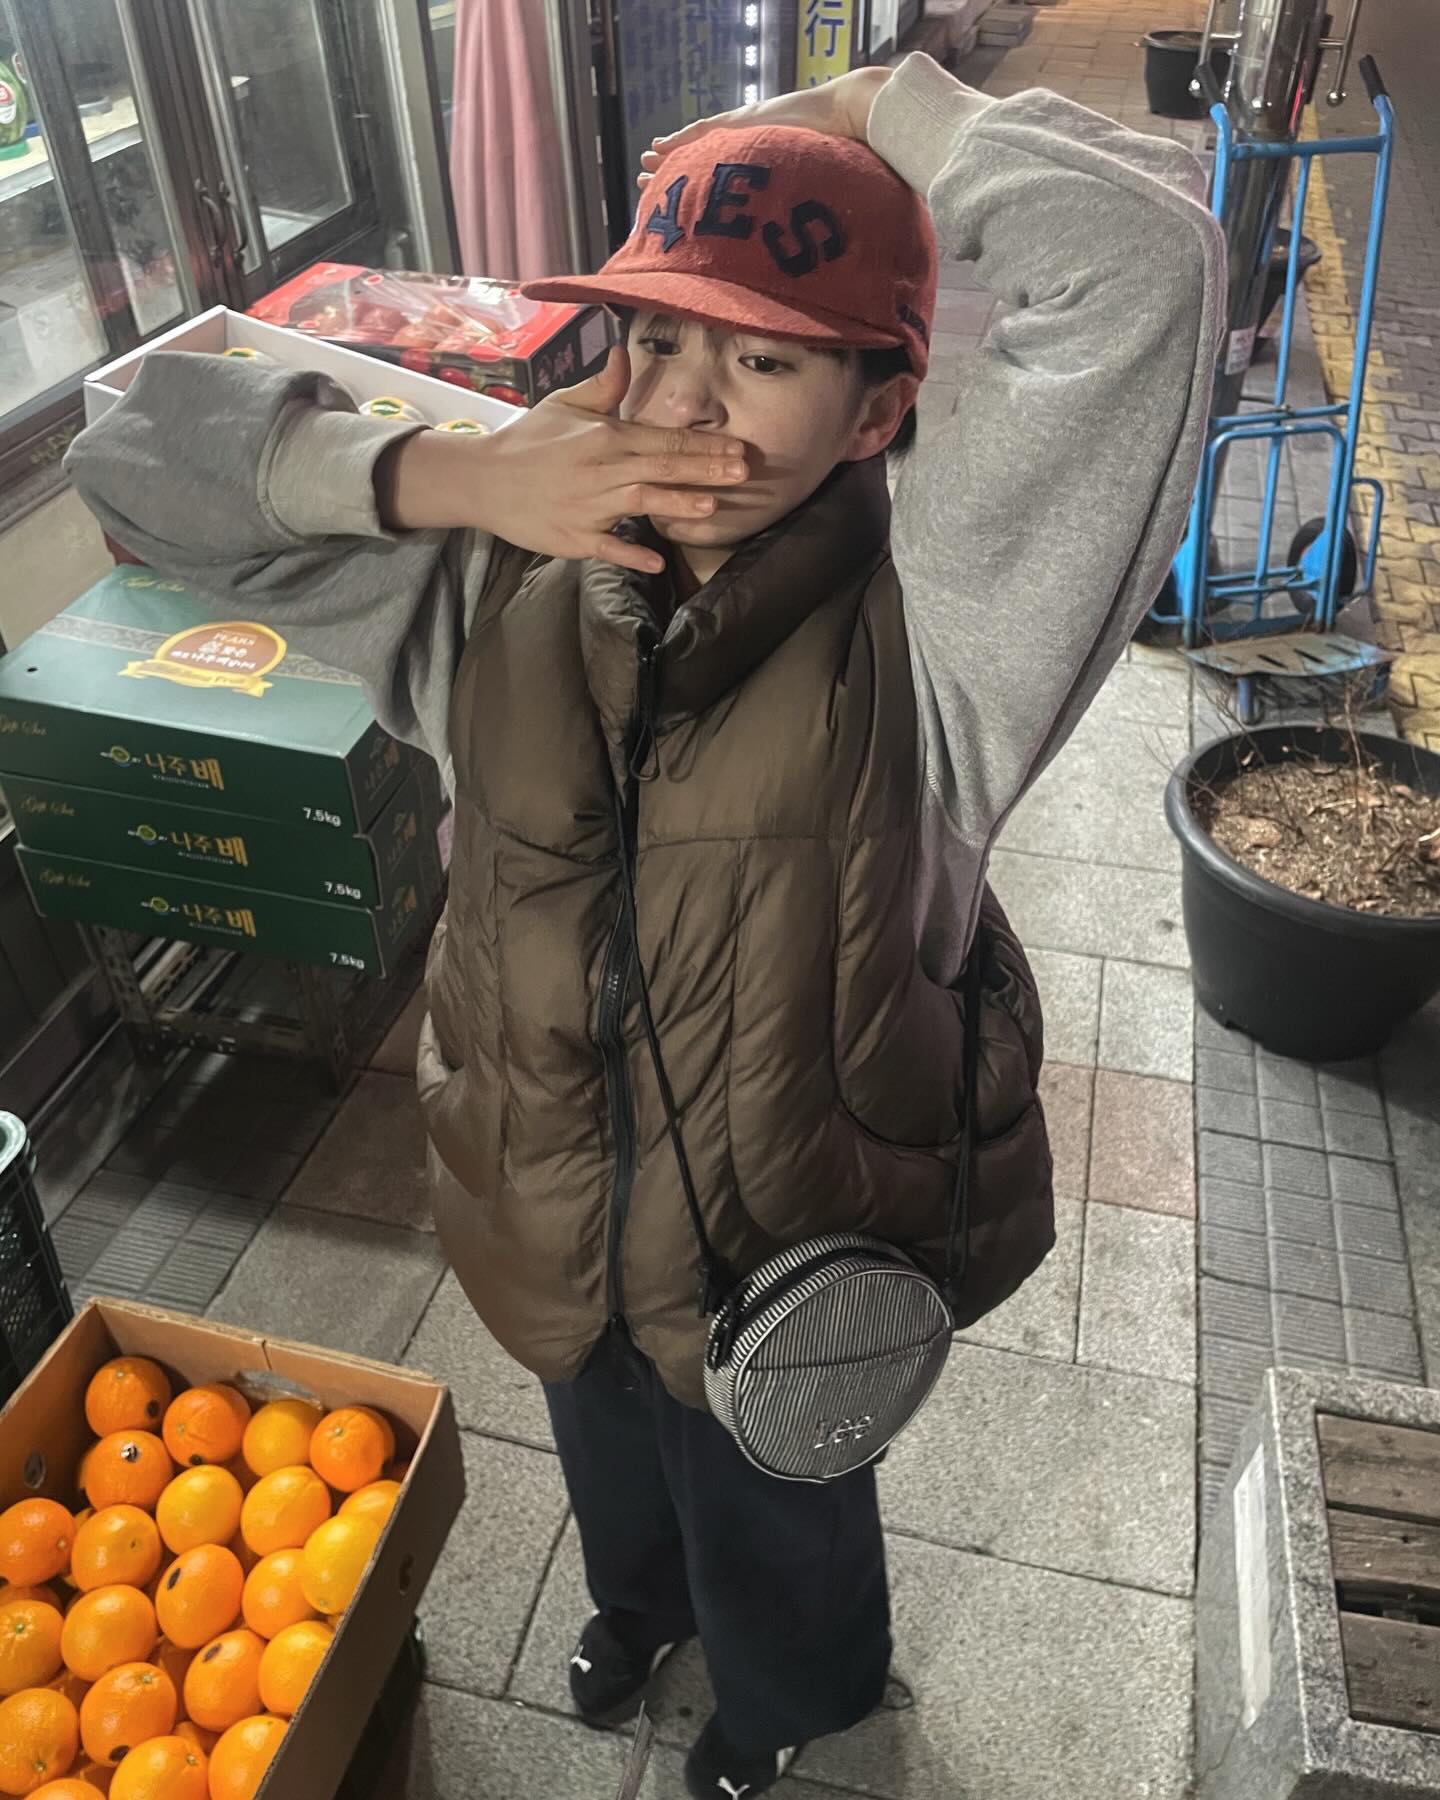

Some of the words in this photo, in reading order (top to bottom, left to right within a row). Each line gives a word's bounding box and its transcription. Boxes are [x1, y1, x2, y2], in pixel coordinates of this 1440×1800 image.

[646, 163, 849, 278] YES
[303, 806, 342, 828] 7.5kg
[323, 881, 362, 900] 7.5kg
[328, 951, 366, 971] 7.5kg
[814, 1415, 873, 1449] Lee
